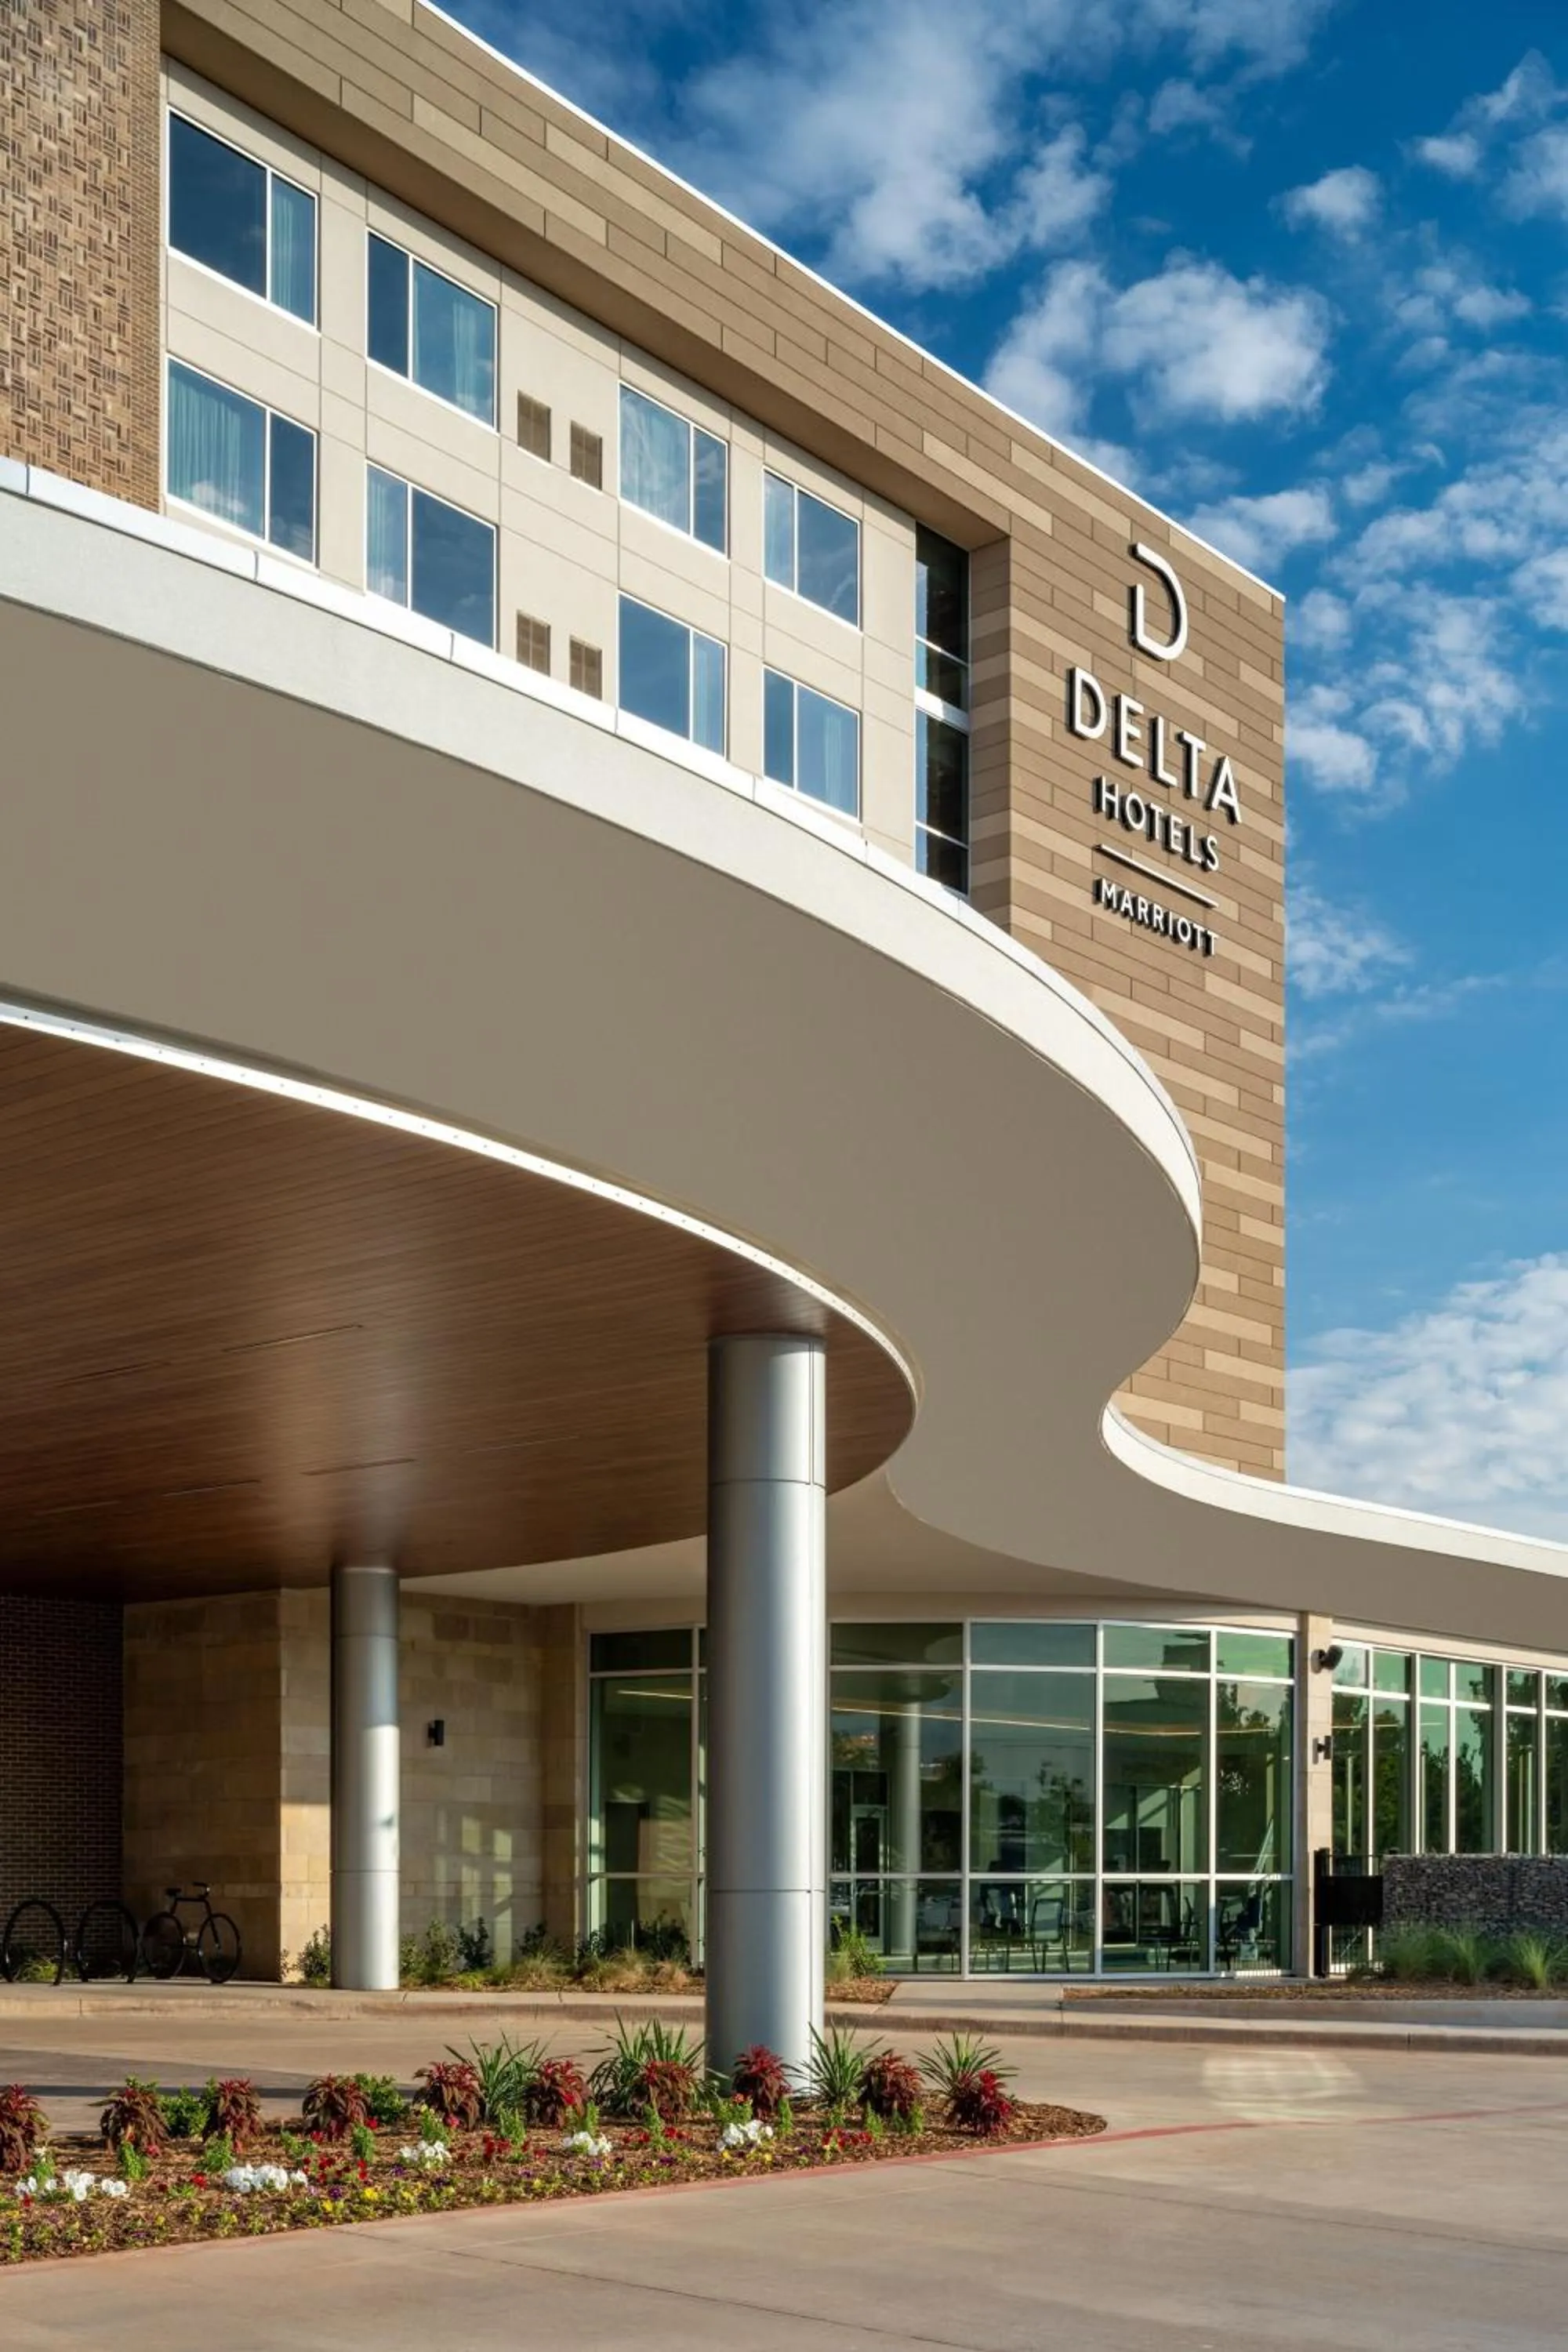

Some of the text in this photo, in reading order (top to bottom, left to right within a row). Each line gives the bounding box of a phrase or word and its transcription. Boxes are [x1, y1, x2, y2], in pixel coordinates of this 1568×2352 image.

[1069, 666, 1242, 826] DELTA
[1097, 775, 1220, 873] HOTELS
[1097, 877, 1219, 956] MARRIOTT
